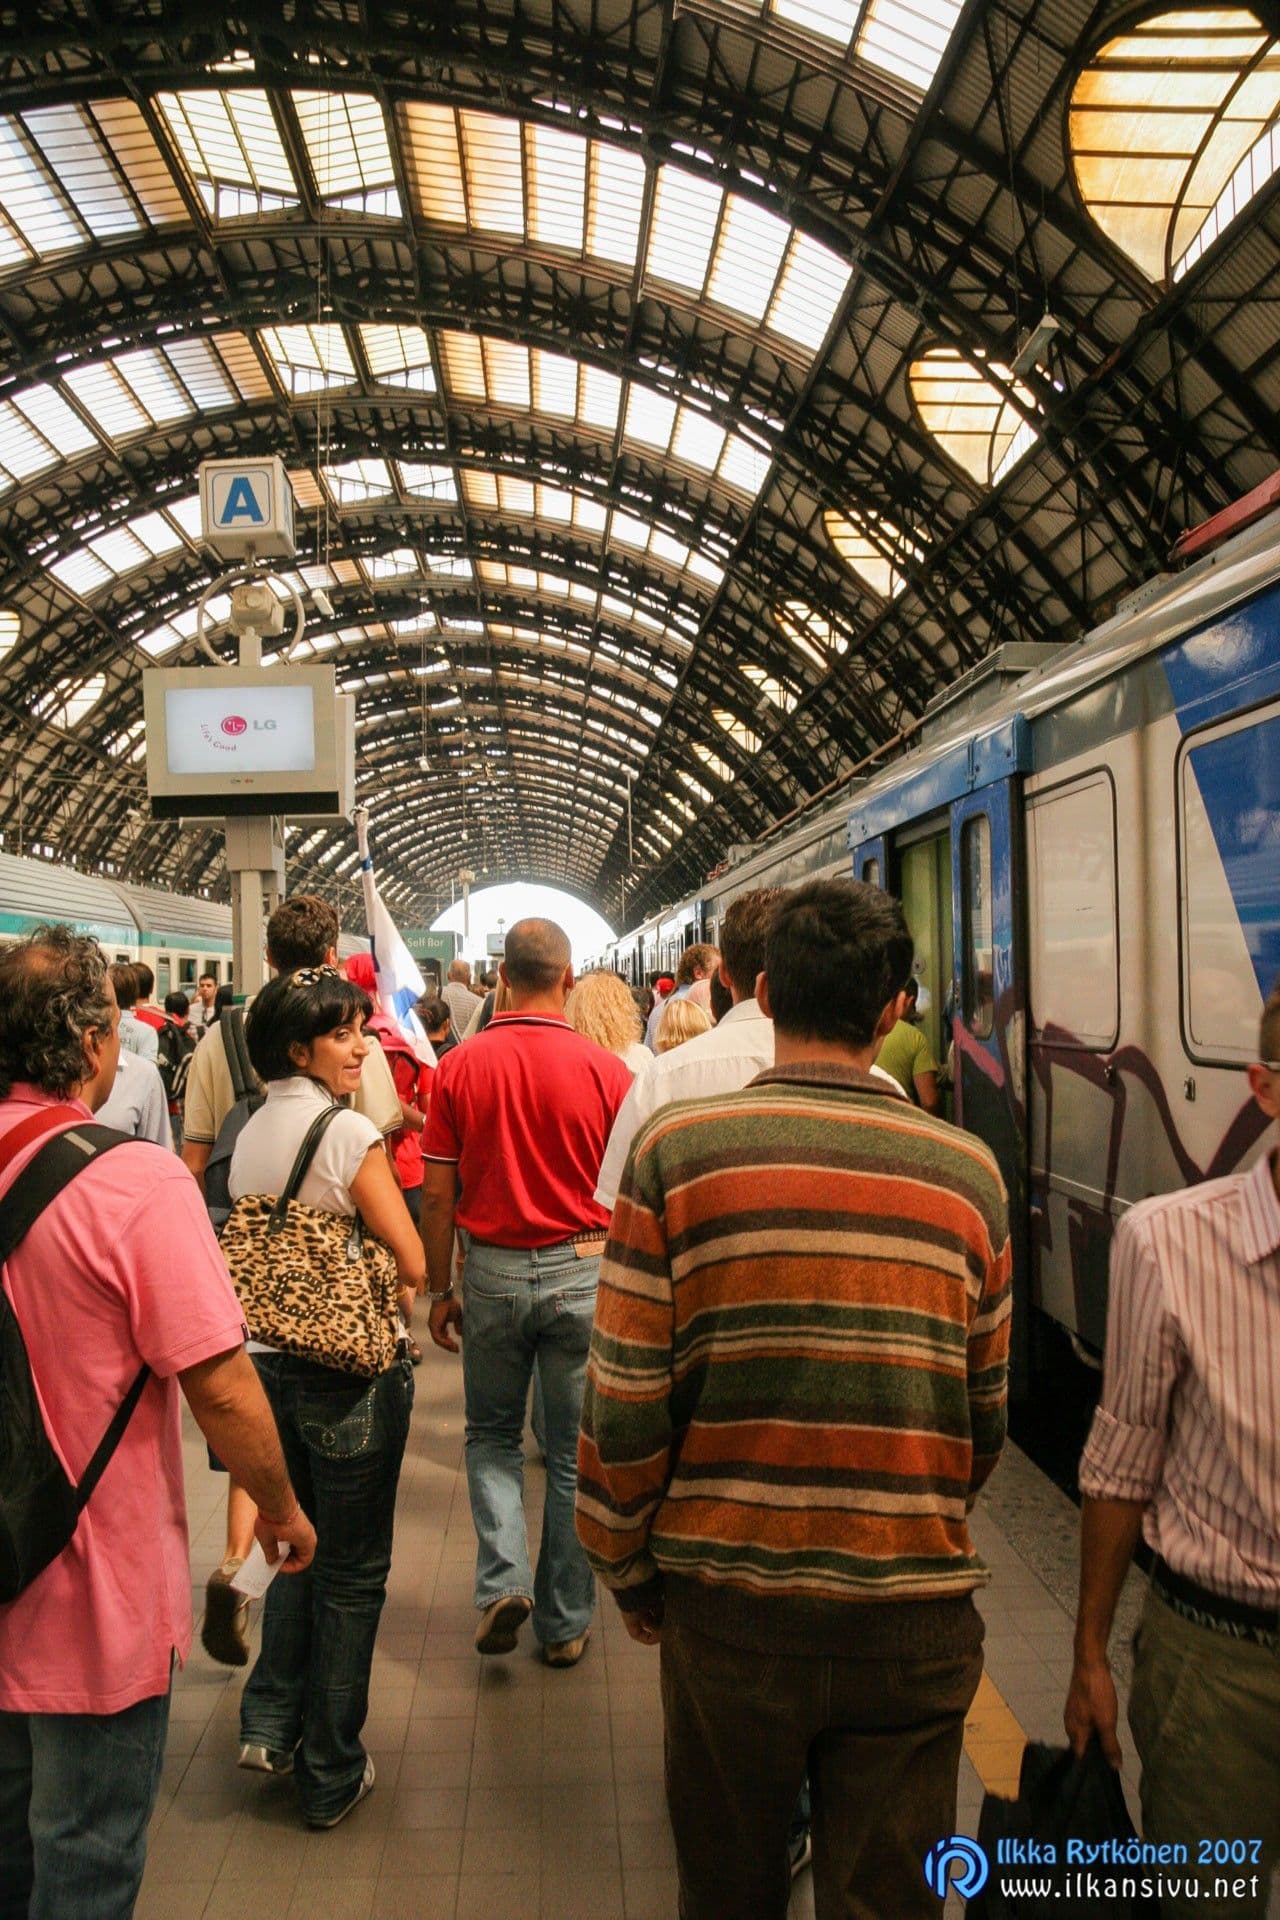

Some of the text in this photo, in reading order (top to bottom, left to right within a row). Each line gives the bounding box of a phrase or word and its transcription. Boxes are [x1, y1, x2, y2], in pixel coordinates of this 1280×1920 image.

[220, 477, 264, 524] A
[253, 719, 277, 730] LG
[407, 937, 444, 947] Self Bar
